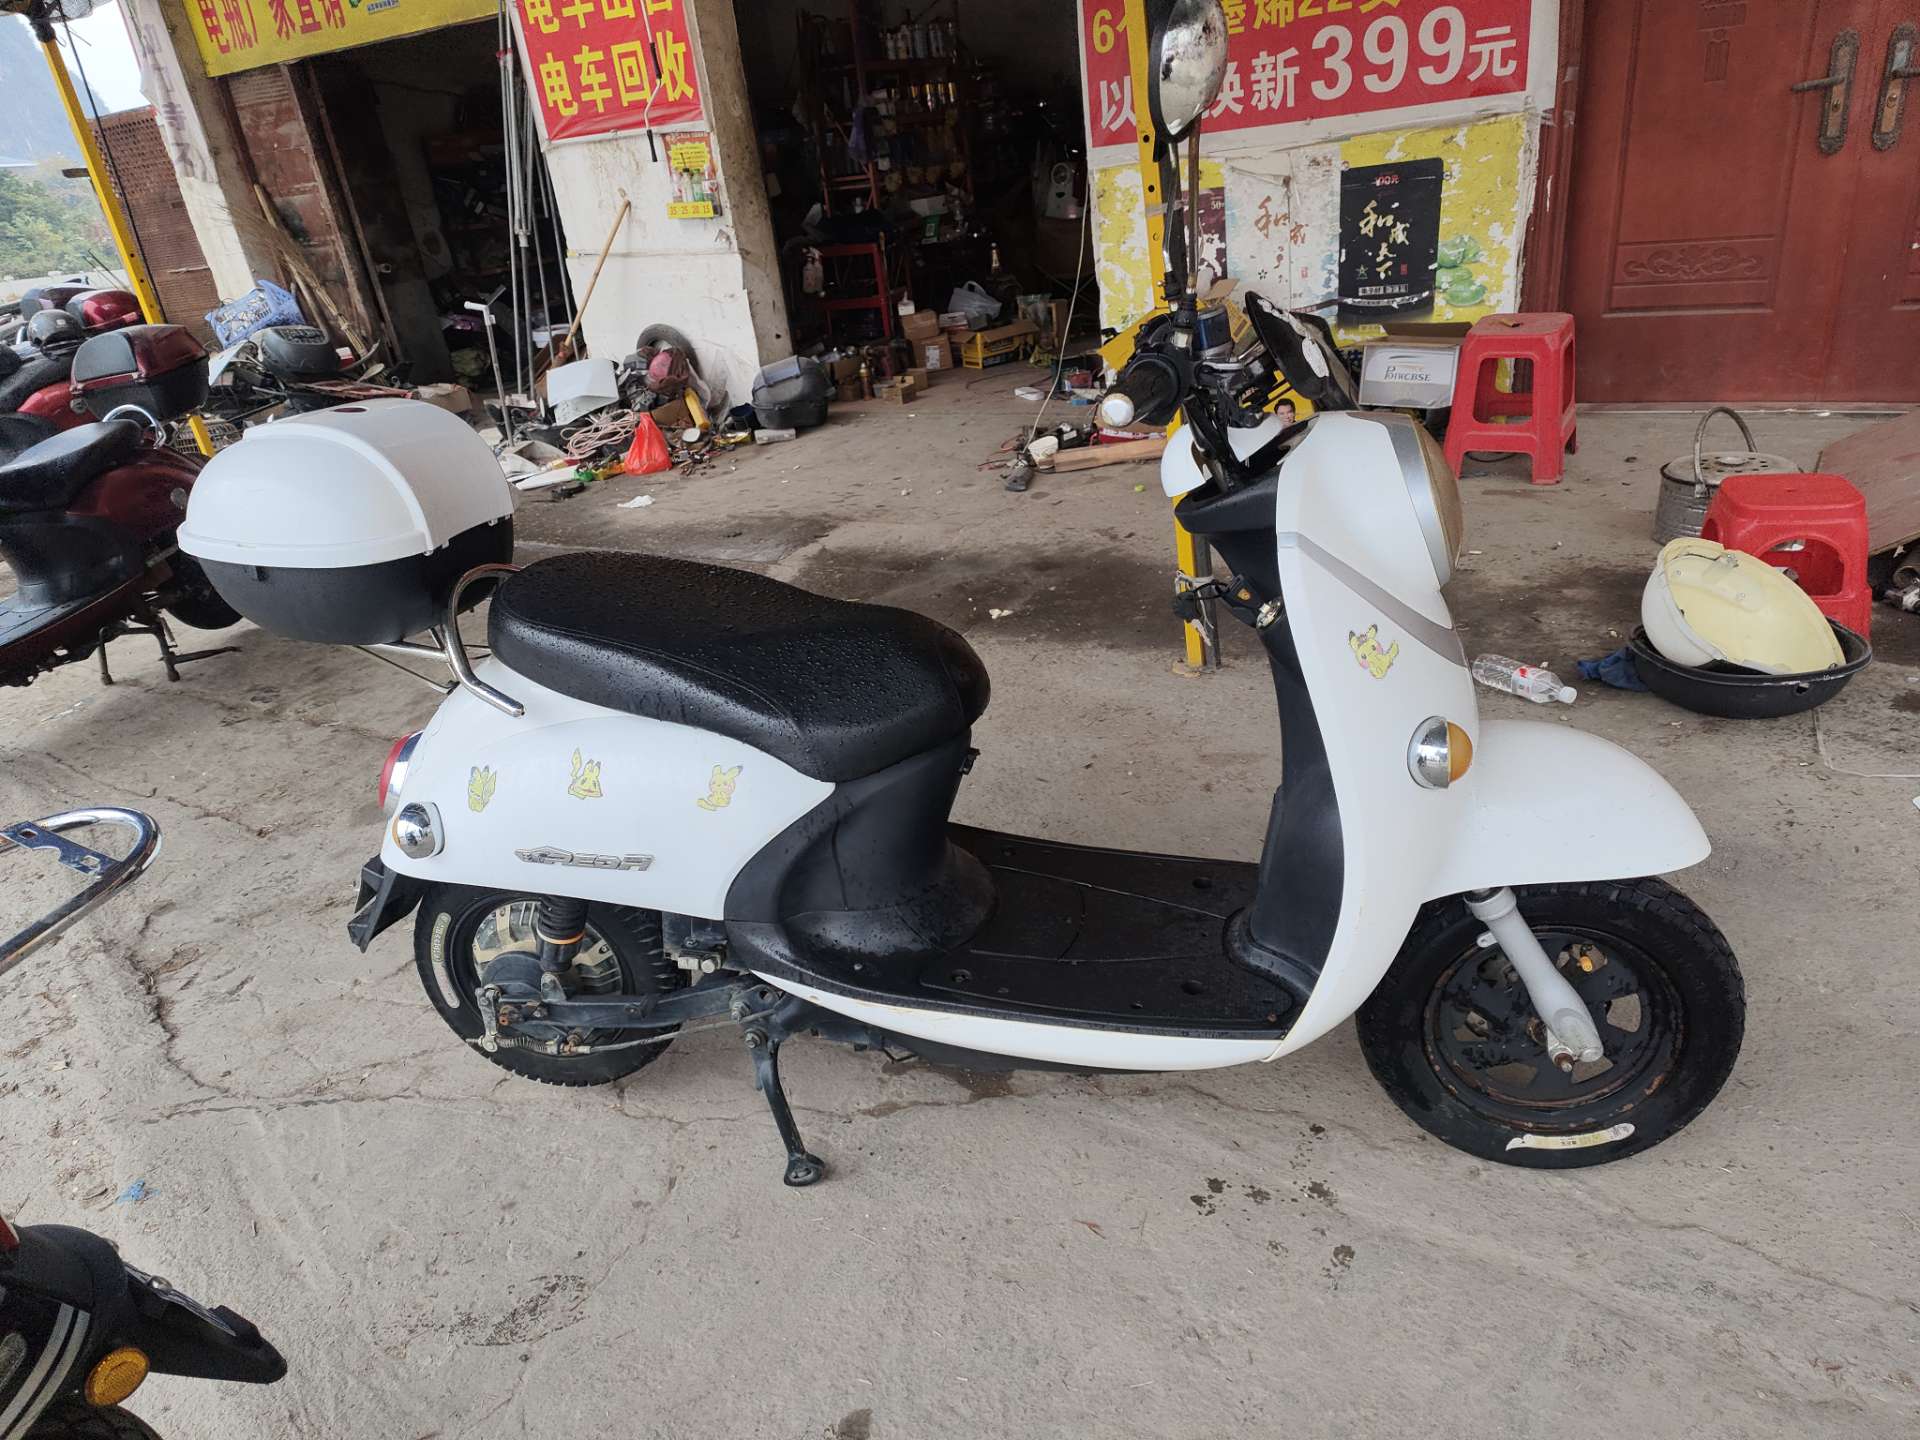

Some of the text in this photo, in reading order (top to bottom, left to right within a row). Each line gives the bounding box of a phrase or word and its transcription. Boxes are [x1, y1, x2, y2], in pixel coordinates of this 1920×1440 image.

[539, 31, 694, 116] 电车回收
[1101, 5, 1517, 131] 以换新399元
